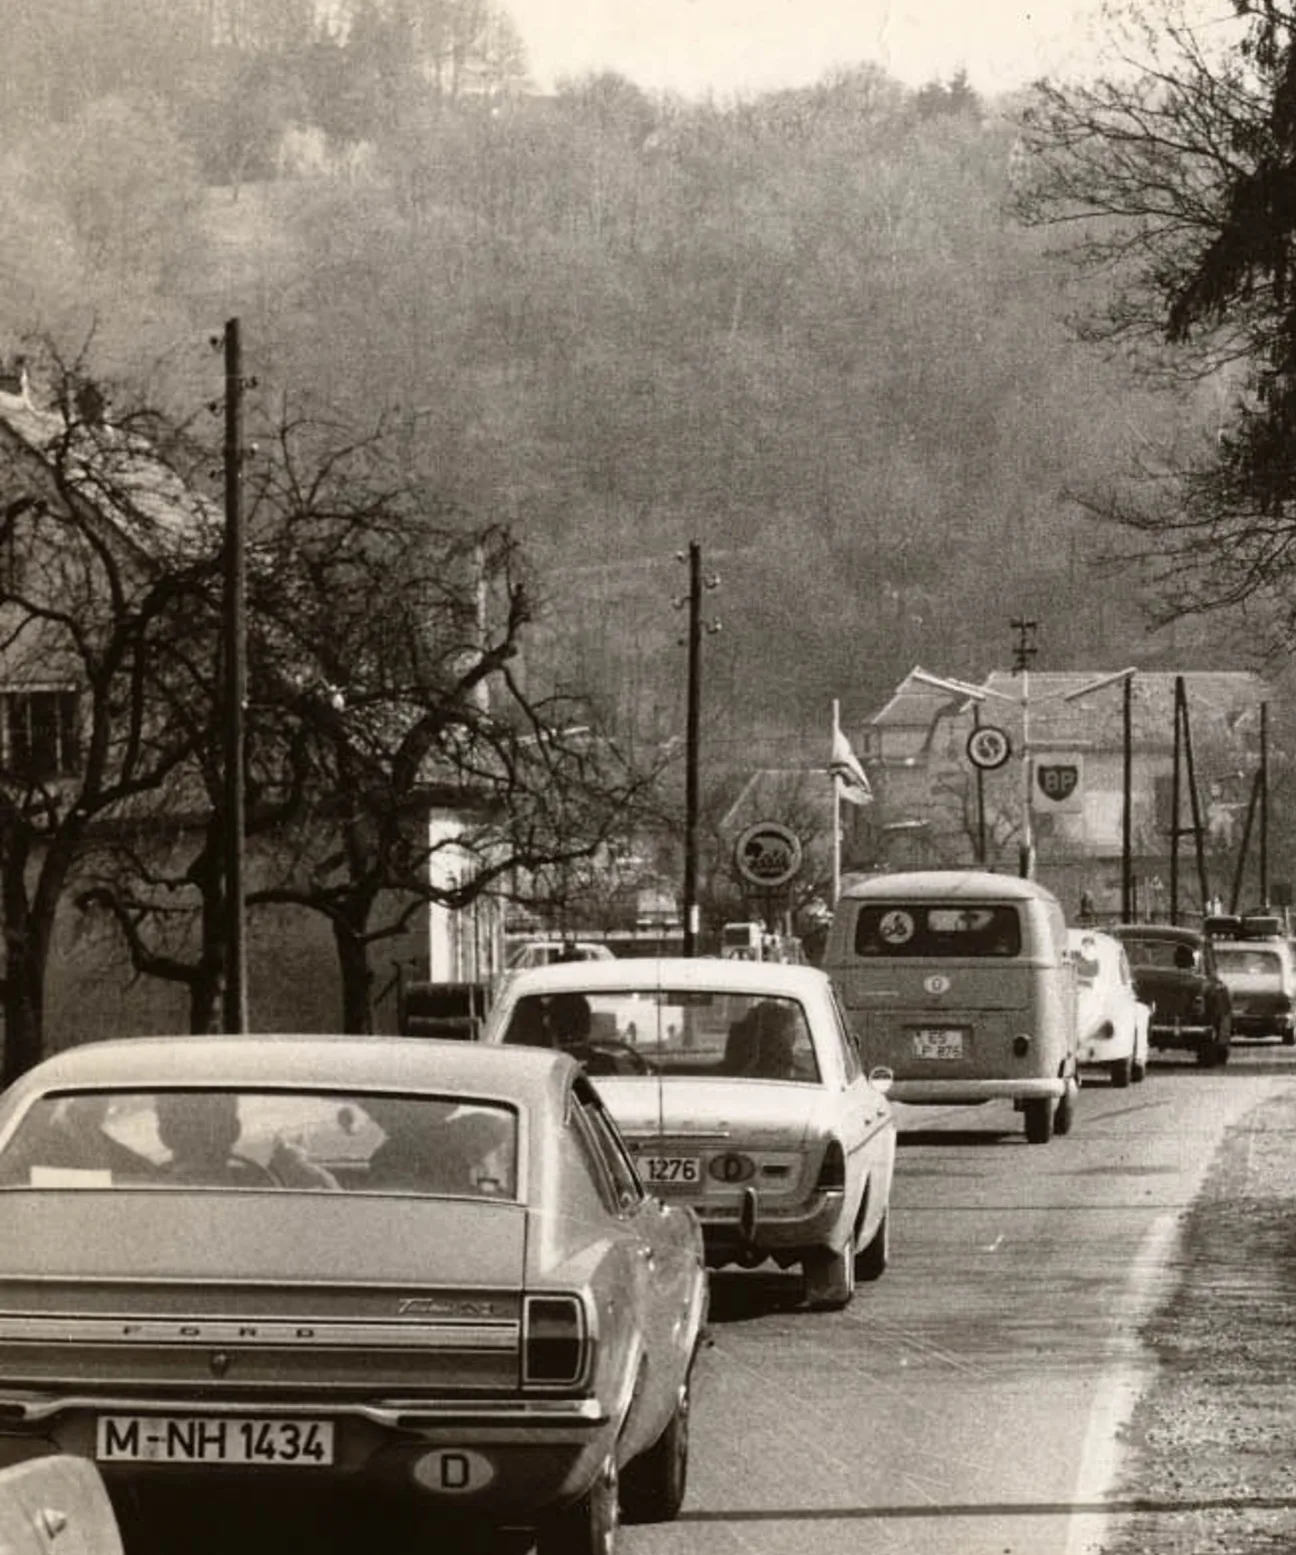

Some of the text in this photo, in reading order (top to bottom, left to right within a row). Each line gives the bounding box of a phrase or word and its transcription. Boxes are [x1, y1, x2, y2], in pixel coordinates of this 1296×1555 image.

[1044, 770, 1076, 791] BP
[648, 1159, 696, 1181] 1276
[724, 1154, 742, 1181] D
[240, 1421, 326, 1462] 1434
[440, 1453, 470, 1490] D
